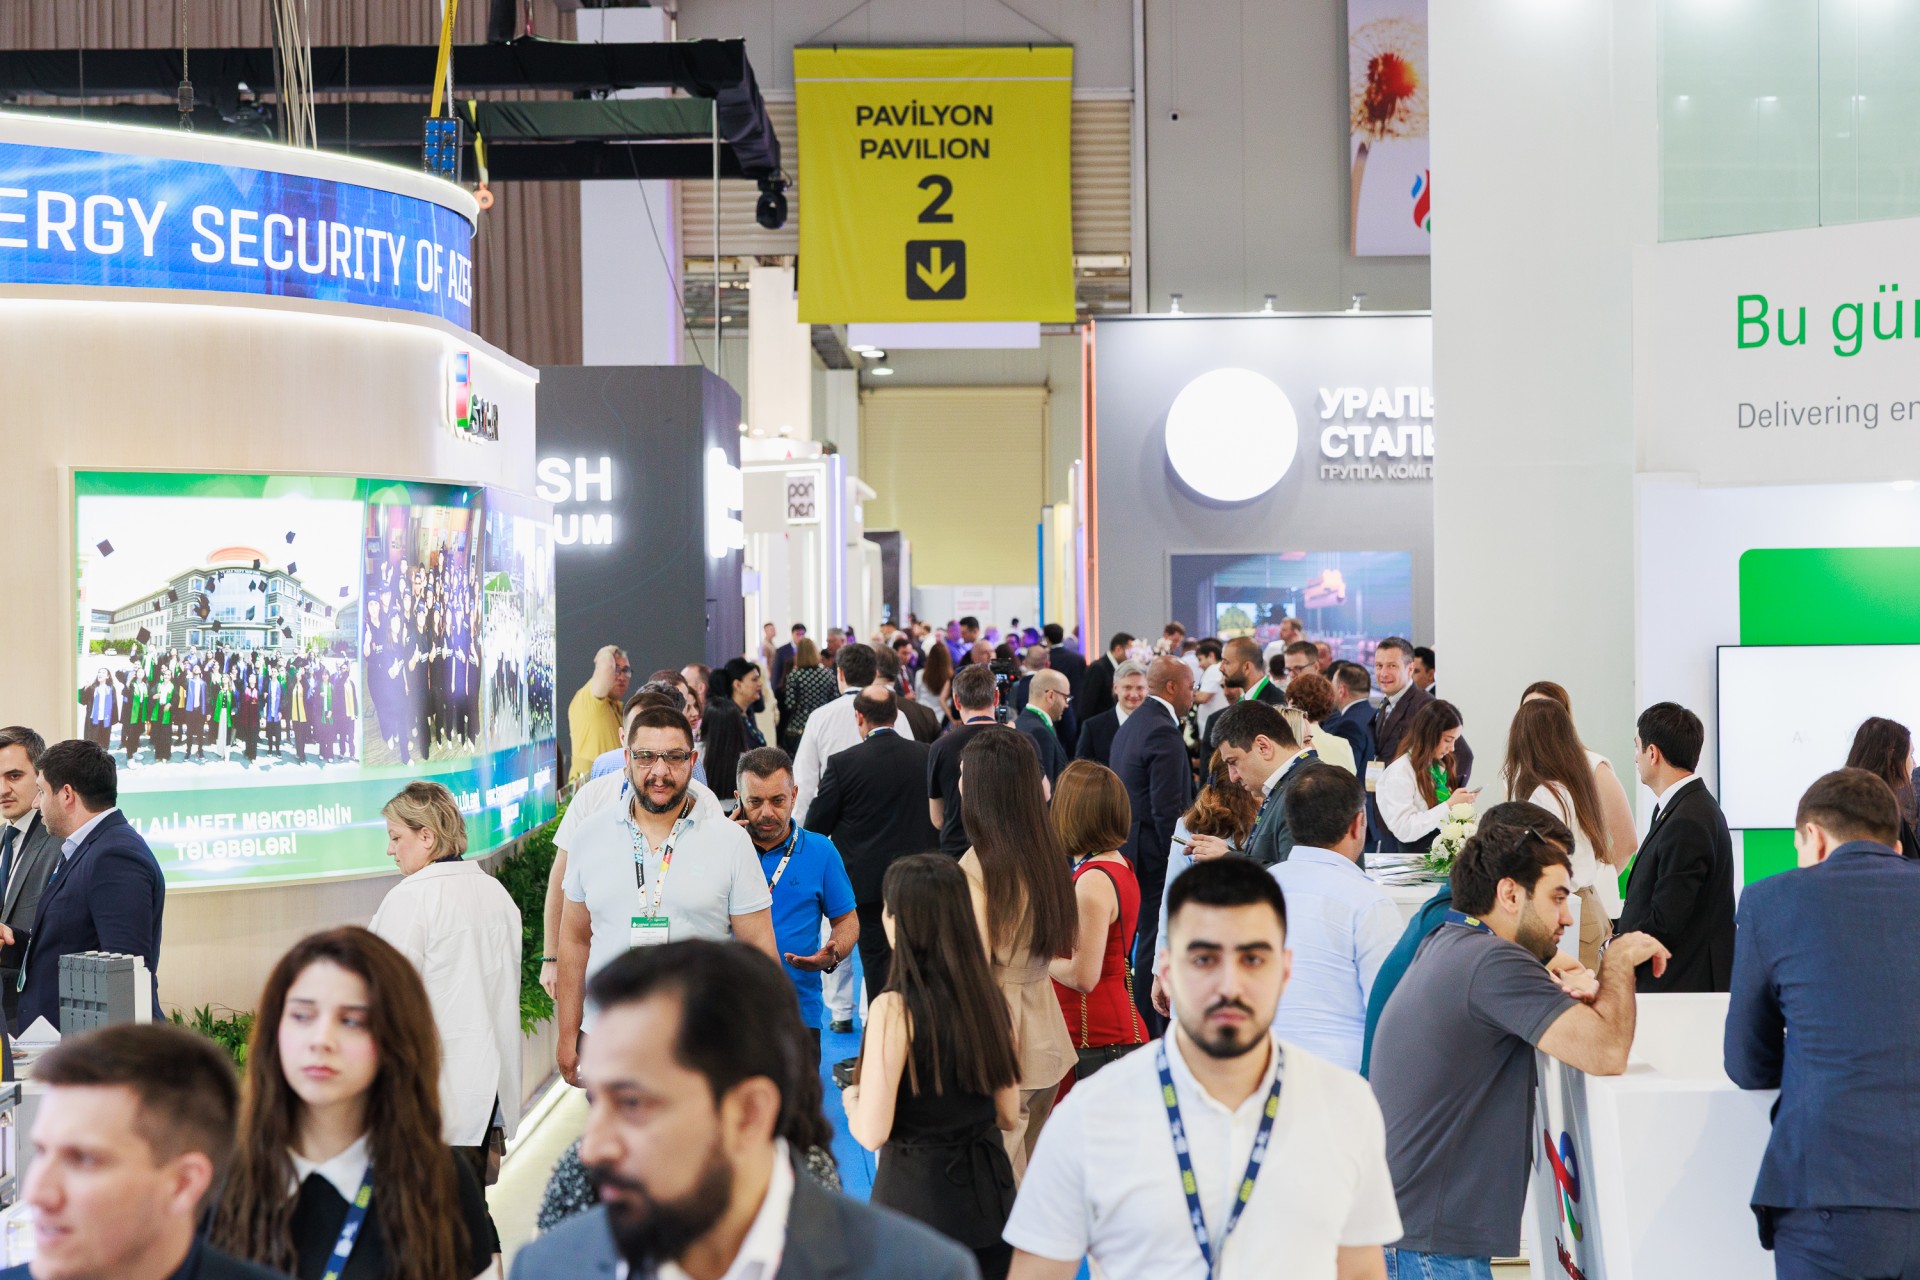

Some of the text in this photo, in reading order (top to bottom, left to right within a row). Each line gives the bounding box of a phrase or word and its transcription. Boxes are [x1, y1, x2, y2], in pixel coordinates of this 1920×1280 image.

[856, 99, 993, 126] PAVİLYON
[860, 138, 990, 160] PAVILION
[917, 174, 954, 224] 2
[0, 187, 168, 257] ERGY
[191, 204, 407, 286] SECURITY
[416, 238, 443, 294] OF
[1737, 294, 1806, 349] Bu
[1738, 396, 1879, 429] Delivering
[535, 457, 612, 503] SH
[1320, 464, 1383, 479] ГРУППА
[553, 513, 613, 545] UM
[242, 803, 352, 832] MƏKTƏBİNİN
[174, 832, 297, 861] TƏLƏBƏLƏRİ
